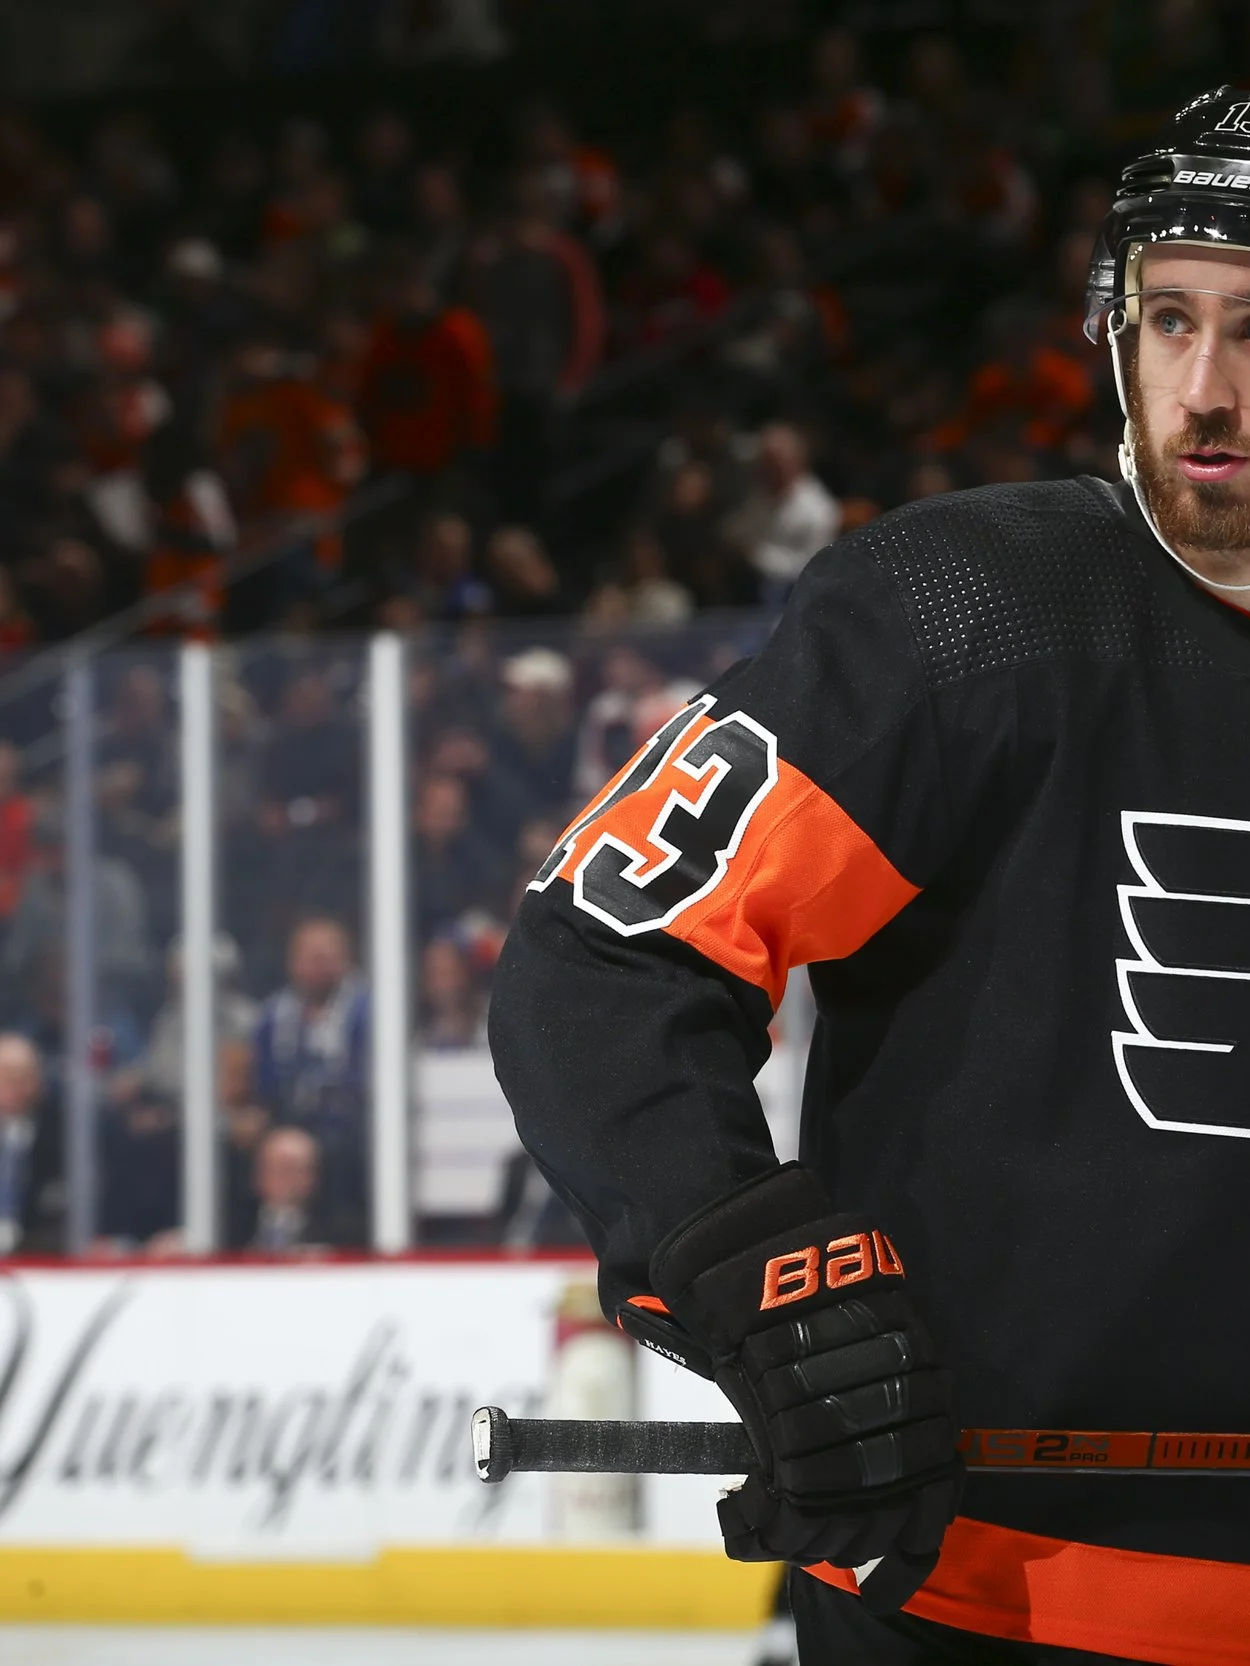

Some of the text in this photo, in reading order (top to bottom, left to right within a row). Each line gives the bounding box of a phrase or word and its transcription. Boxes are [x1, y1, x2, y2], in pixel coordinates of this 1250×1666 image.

[526, 693, 779, 937] 13
[644, 1338, 687, 1367] HAYES
[1069, 1452, 1109, 1463] PRO
